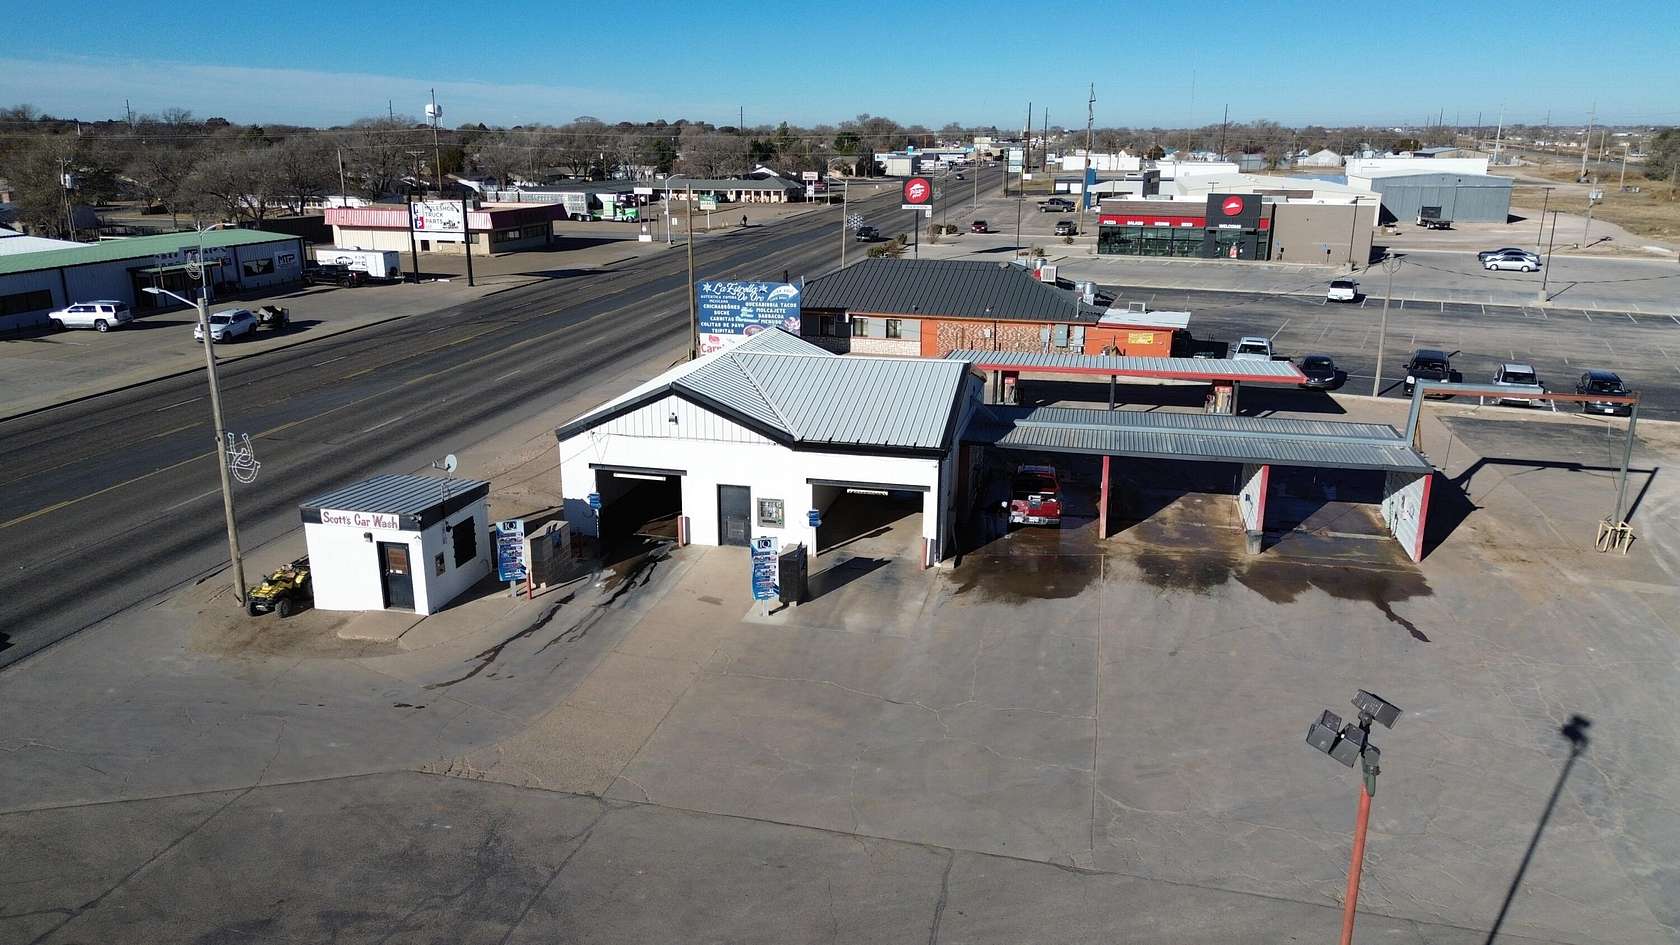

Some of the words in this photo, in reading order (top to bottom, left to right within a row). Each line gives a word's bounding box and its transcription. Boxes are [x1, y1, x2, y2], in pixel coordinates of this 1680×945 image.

[712, 282, 726, 295] La
[737, 293, 747, 301] De
[750, 292, 765, 301] Oro
[323, 511, 351, 525] Scott's
[354, 513, 370, 527] Car
[372, 514, 398, 529] Wash
